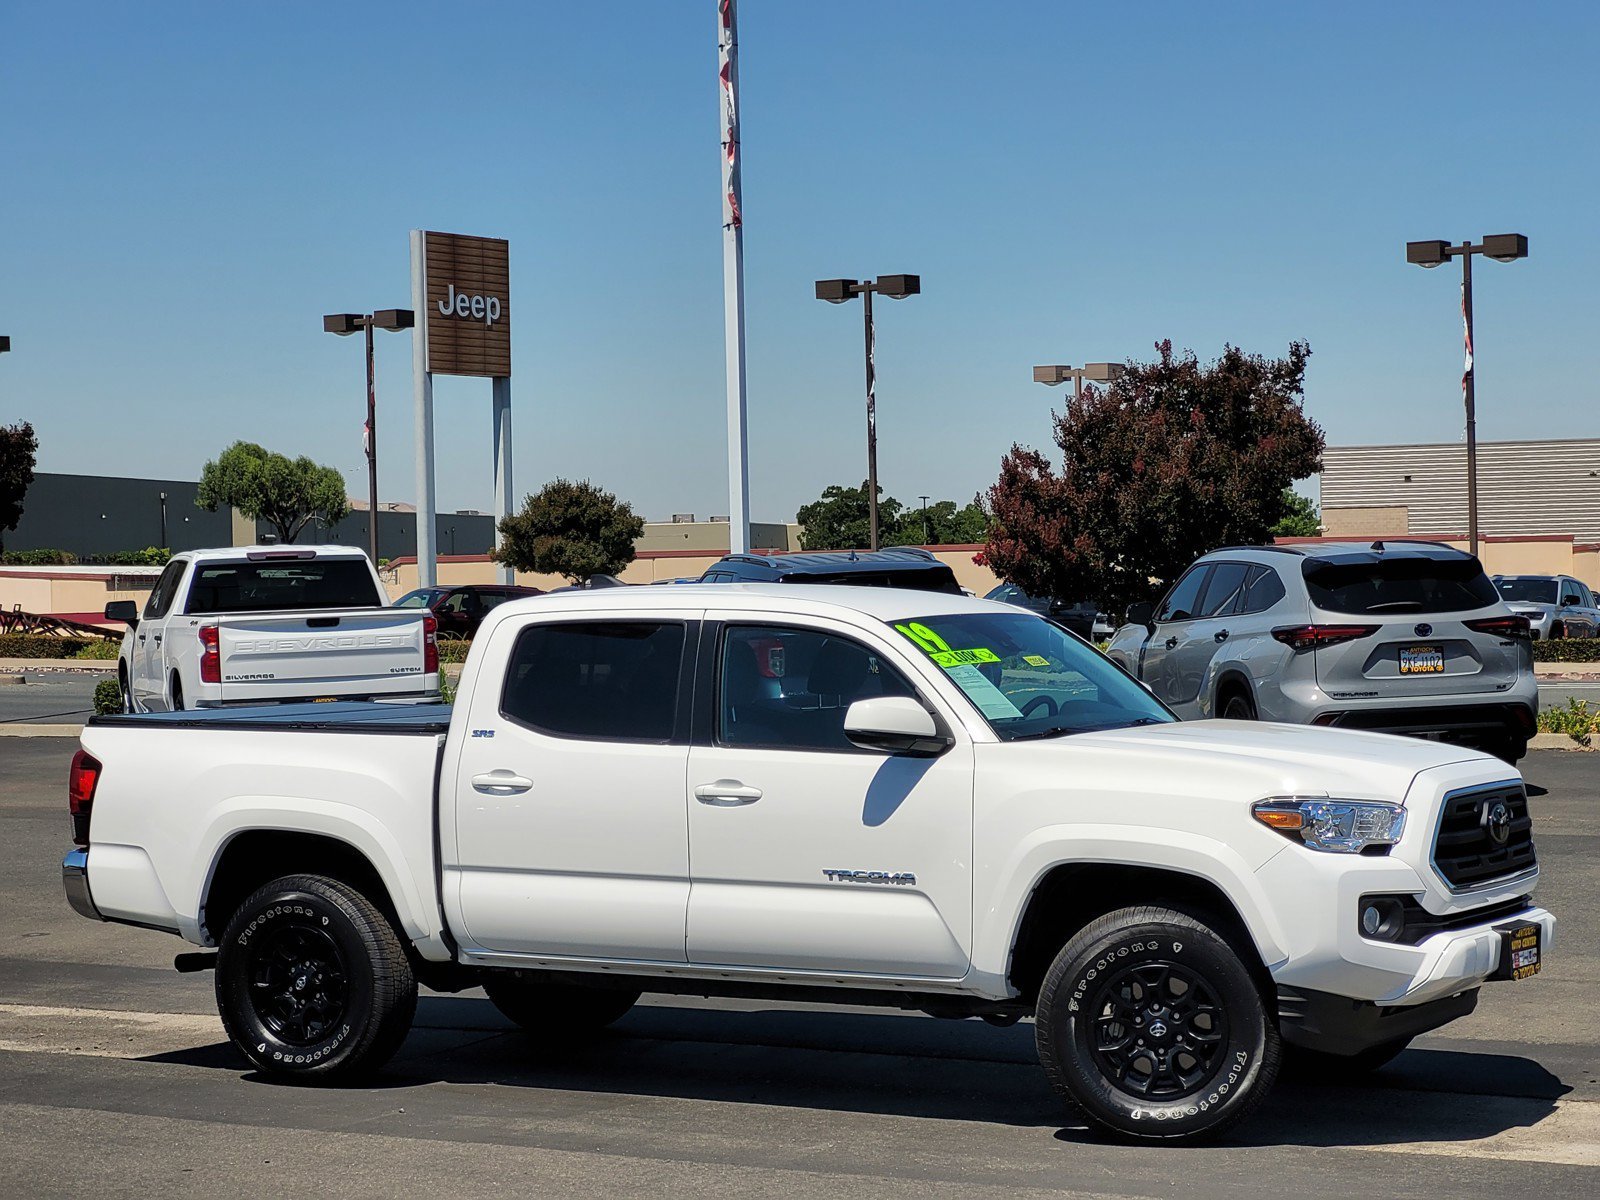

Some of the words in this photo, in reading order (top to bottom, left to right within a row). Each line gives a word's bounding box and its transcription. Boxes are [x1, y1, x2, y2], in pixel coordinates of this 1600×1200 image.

[438, 284, 501, 326] Jeep
[233, 634, 411, 653] CHEVROLET
[894, 622, 950, 652] 19
[225, 673, 275, 681] SILVERADO
[822, 869, 917, 886] TACOMA
[238, 905, 314, 946] Firestone
[1068, 940, 1159, 1012] Firestone
[273, 1023, 351, 1064] Firestone
[1156, 1051, 1248, 1121] Firestone
